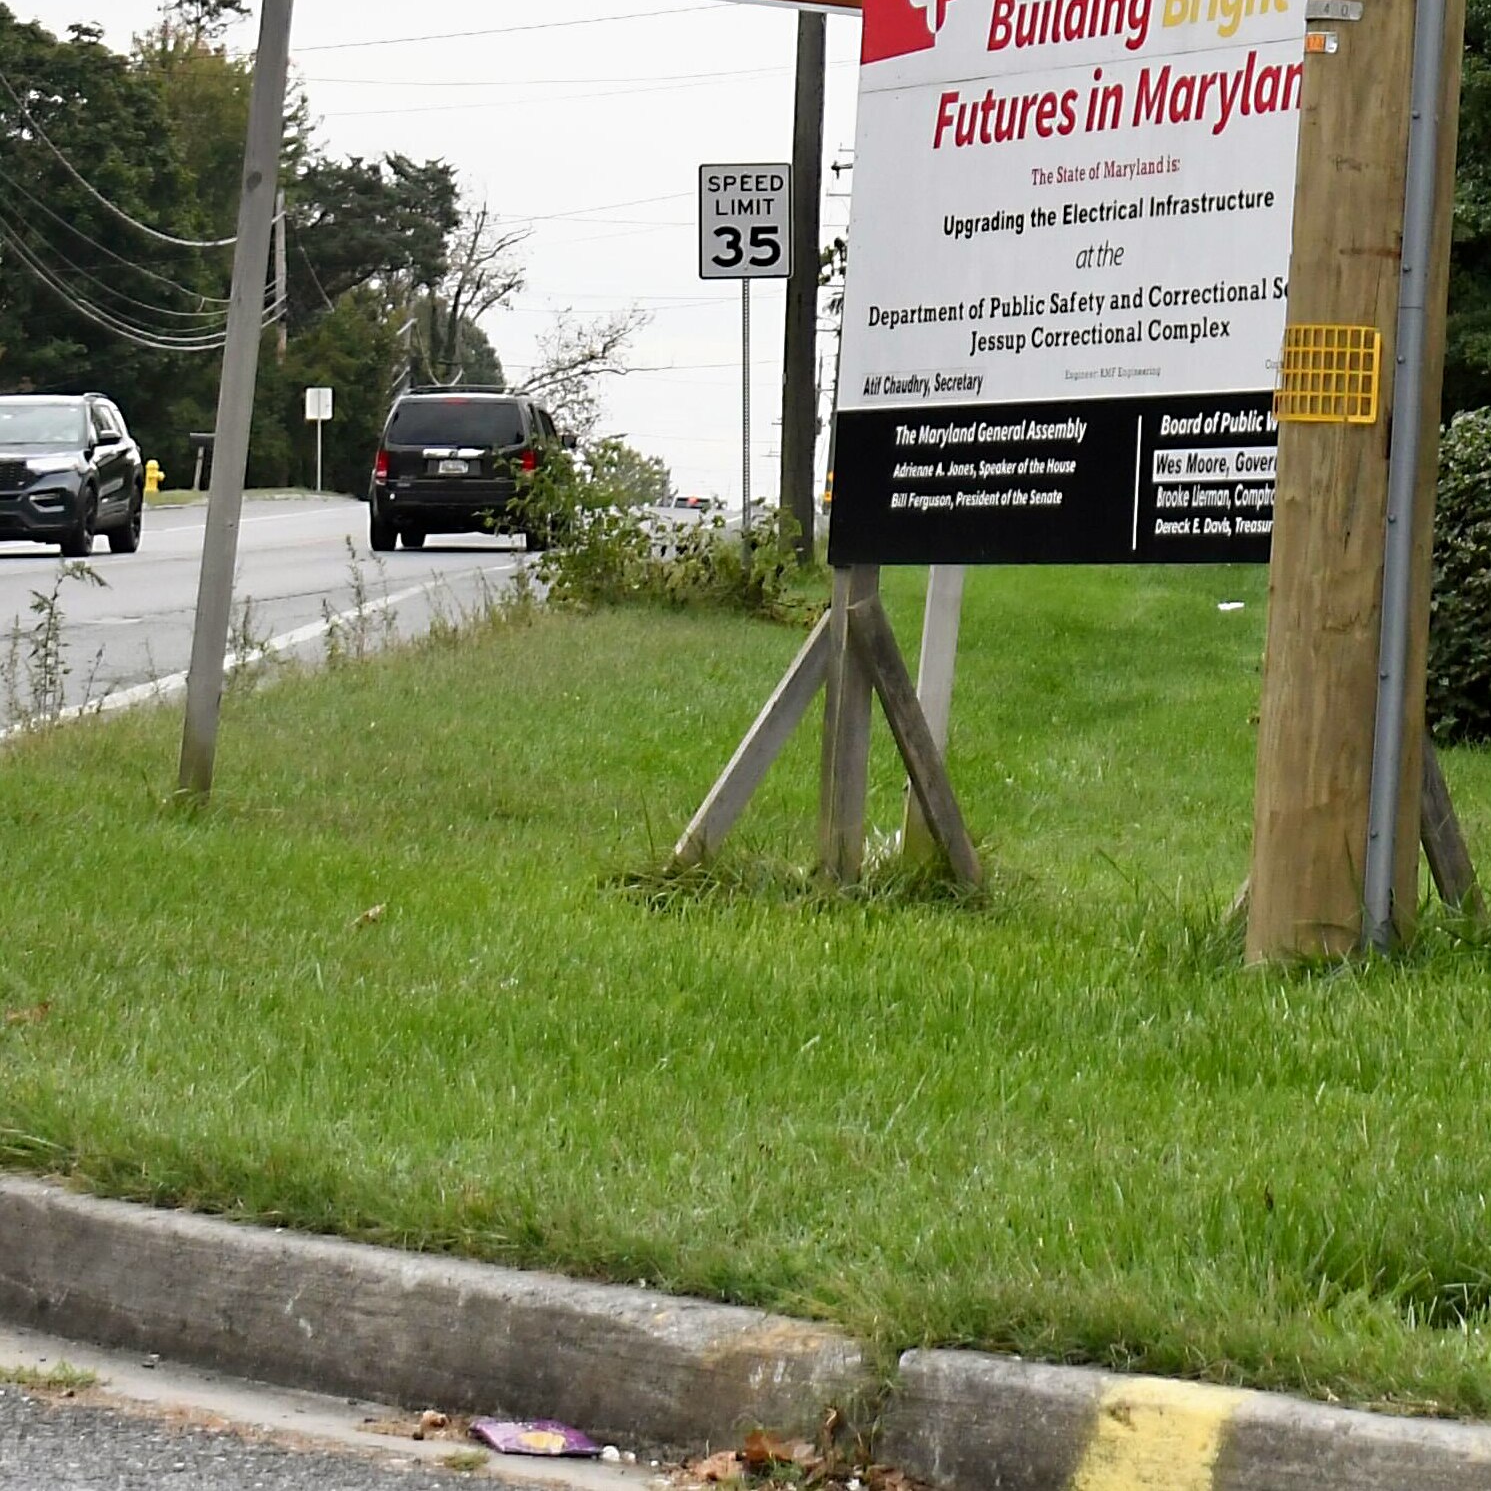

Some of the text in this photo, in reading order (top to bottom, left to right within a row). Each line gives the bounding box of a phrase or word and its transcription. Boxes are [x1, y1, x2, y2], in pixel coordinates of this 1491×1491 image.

[933, 87, 1079, 149] Futures
[1085, 67, 1123, 132] in
[708, 174, 784, 192] SPEED
[1032, 155, 1180, 186] The State of Maryland is:
[716, 199, 775, 215] LIMIT
[944, 189, 1274, 240] Upgrading the Electrical Infrastructure
[711, 226, 781, 268] 35
[1076, 239, 1124, 269] at the
[868, 302, 964, 329] Department
[969, 298, 985, 320] of
[990, 295, 1045, 318] Public
[1050, 291, 1105, 316] Safety
[1110, 287, 1143, 310] and
[1149, 278, 1266, 308] Correctional
[970, 316, 1230, 356] Jessup Correctional Complex
[863, 373, 984, 398] Atif Chaudhry, Secretary
[895, 417, 1087, 449] The Maryland General Assembly
[1161, 412, 1203, 436] Board
[1204, 411, 1221, 434] of
[1221, 410, 1264, 433] Public
[935, 461, 945, 478] A.
[947, 460, 976, 479] Jones,
[979, 459, 1016, 478] Speaker
[1017, 458, 1029, 474] of
[1030, 458, 1045, 474] the
[1046, 458, 1077, 474] House
[1156, 453, 1182, 474] Wes
[1186, 452, 1230, 478] Moore,
[891, 489, 1062, 511] Bill Ferguson, President of the Senate
[1156, 485, 1189, 508] Brooke
[1155, 517, 1191, 534] Dereck
[1203, 516, 1231, 537] Davis,
